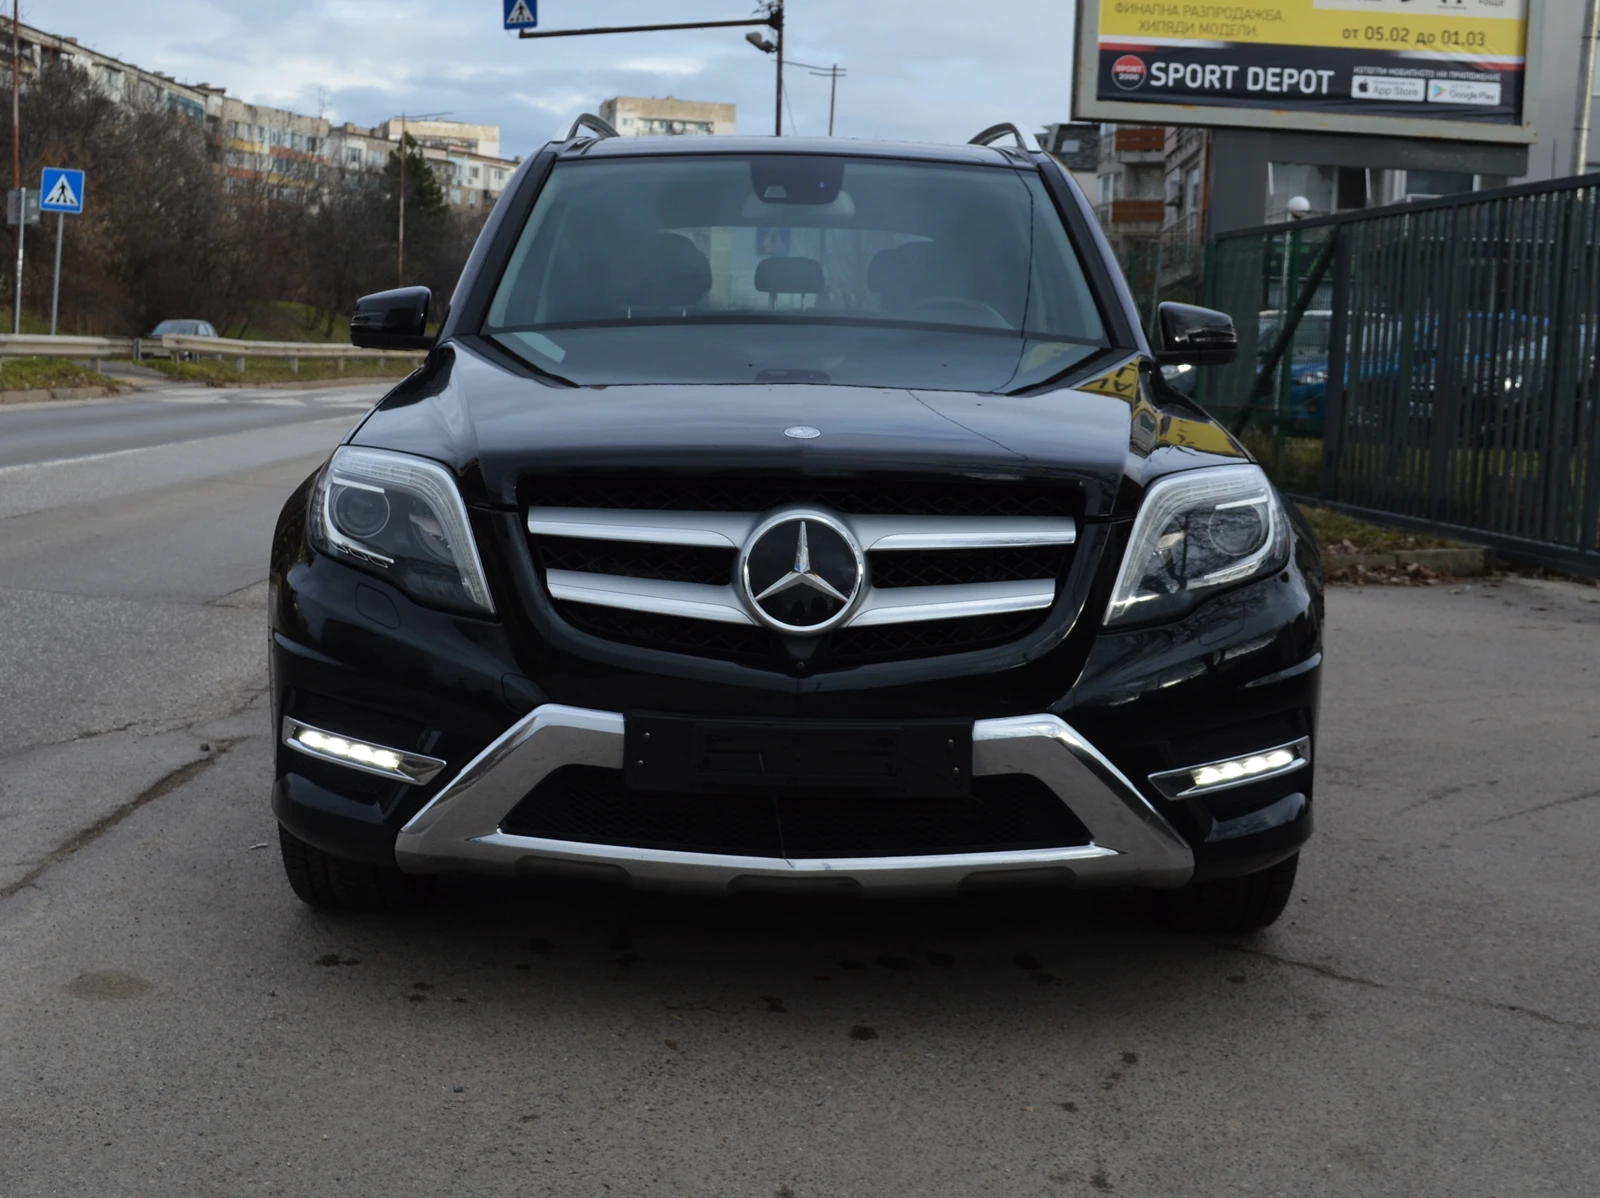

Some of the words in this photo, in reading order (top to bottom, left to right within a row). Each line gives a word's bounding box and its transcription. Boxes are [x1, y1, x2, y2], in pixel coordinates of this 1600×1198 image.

[1114, 2, 1179, 16] ФИНАЛНА
[1139, 20, 1195, 34] ХИЛЯДИ
[1342, 28, 1359, 39] от
[1364, 26, 1410, 42] 05.02
[1415, 32, 1436, 45] до
[1441, 30, 1486, 47] 01.03
[1150, 61, 1239, 90] SPORT
[1246, 65, 1335, 94] DEPOT
